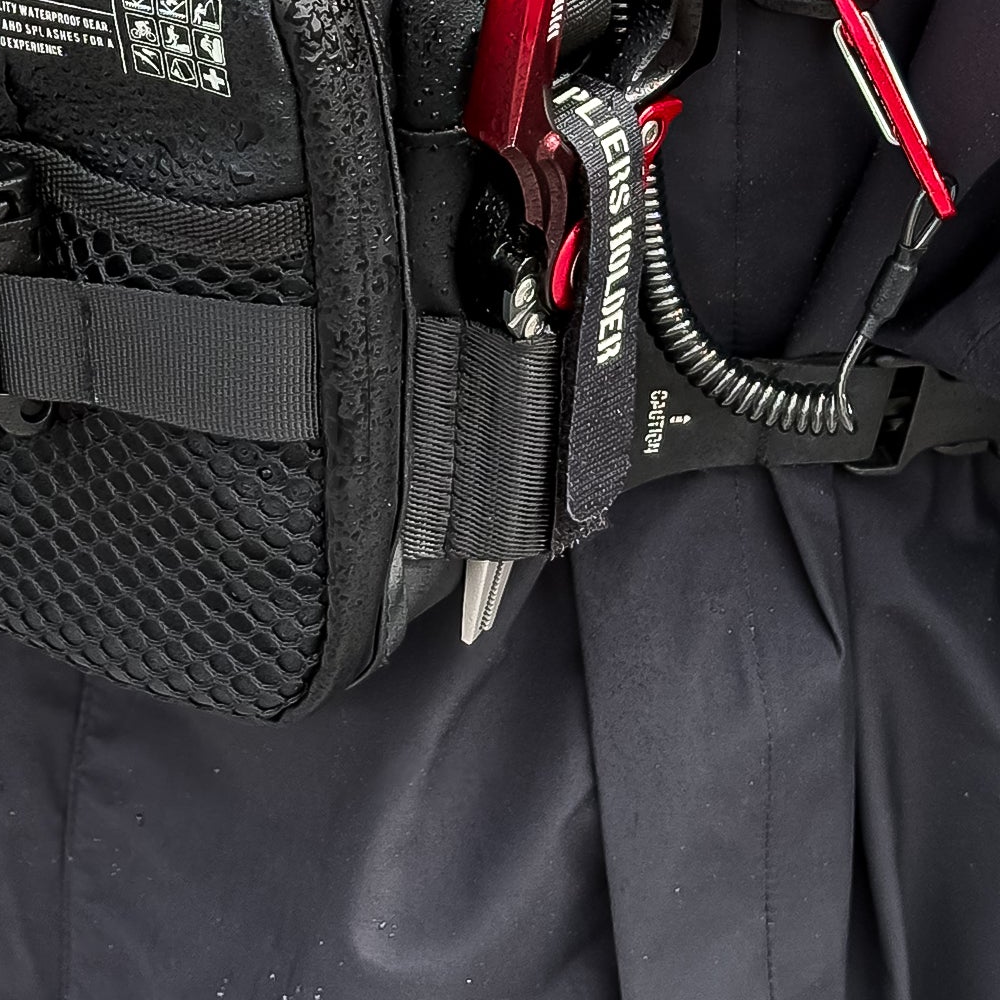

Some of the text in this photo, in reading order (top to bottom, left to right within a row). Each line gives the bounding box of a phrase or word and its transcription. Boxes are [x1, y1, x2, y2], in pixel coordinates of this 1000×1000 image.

[18, 3, 81, 30] WATERPROOF
[1, 17, 23, 34] AND
[25, 21, 81, 44] SPLASHES
[82, 33, 104, 47] FOR
[107, 37, 115, 49] A
